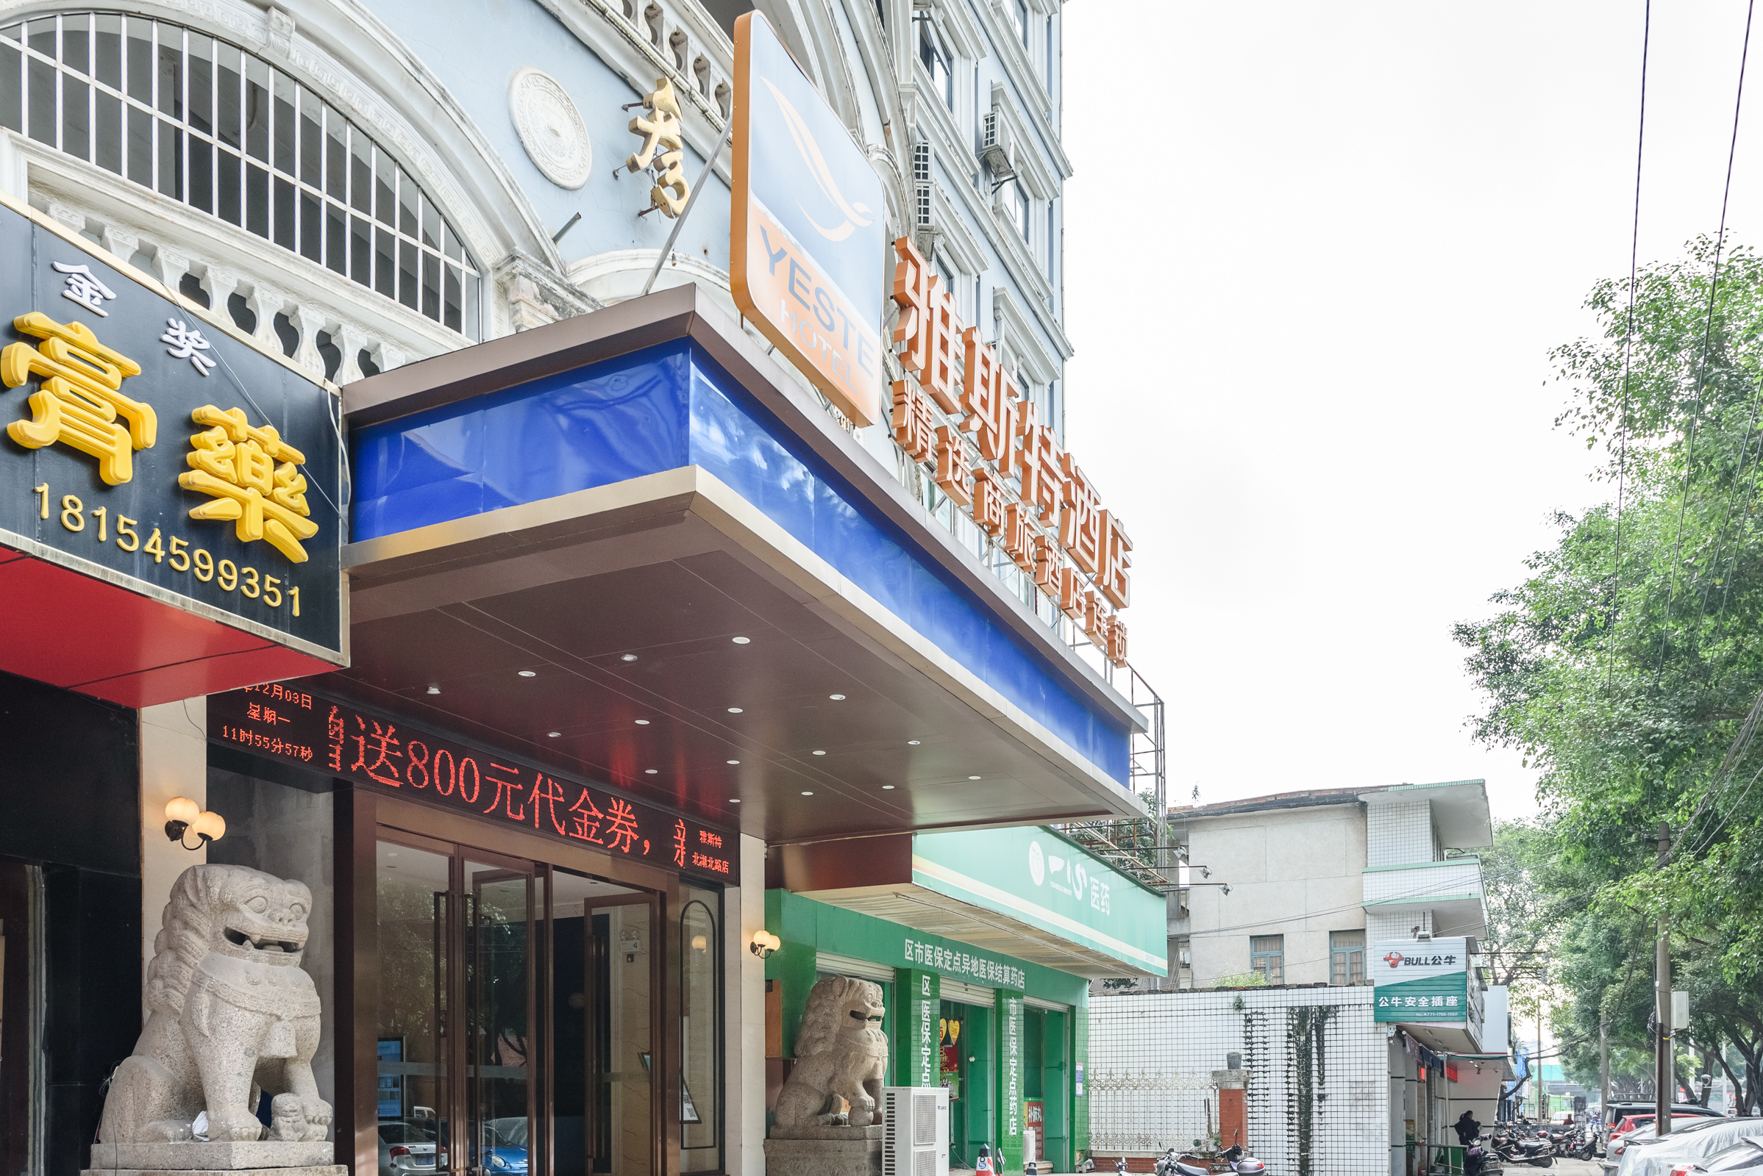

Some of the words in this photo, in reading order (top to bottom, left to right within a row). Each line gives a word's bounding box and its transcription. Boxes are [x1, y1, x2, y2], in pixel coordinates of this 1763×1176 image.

[53, 260, 216, 376] 金奖
[759, 223, 875, 380] YESTE
[780, 298, 858, 394] HOTEL
[893, 235, 1133, 609] 雅斯特酒店
[34, 482, 302, 617] 18154599351
[891, 379, 1129, 669] 精选商旅酒店连锁
[222, 725, 314, 762] 11时55分57秒
[247, 702, 291, 726] 星期一
[692, 851, 730, 874] 北湖北路店
[699, 830, 723, 849] 雅斯特
[904, 938, 1026, 990] 区市医保定点异地医保结算药店
[1378, 995, 1459, 1008] 公牛安全插座
[1008, 997, 1018, 1136] 市医保定点药店
